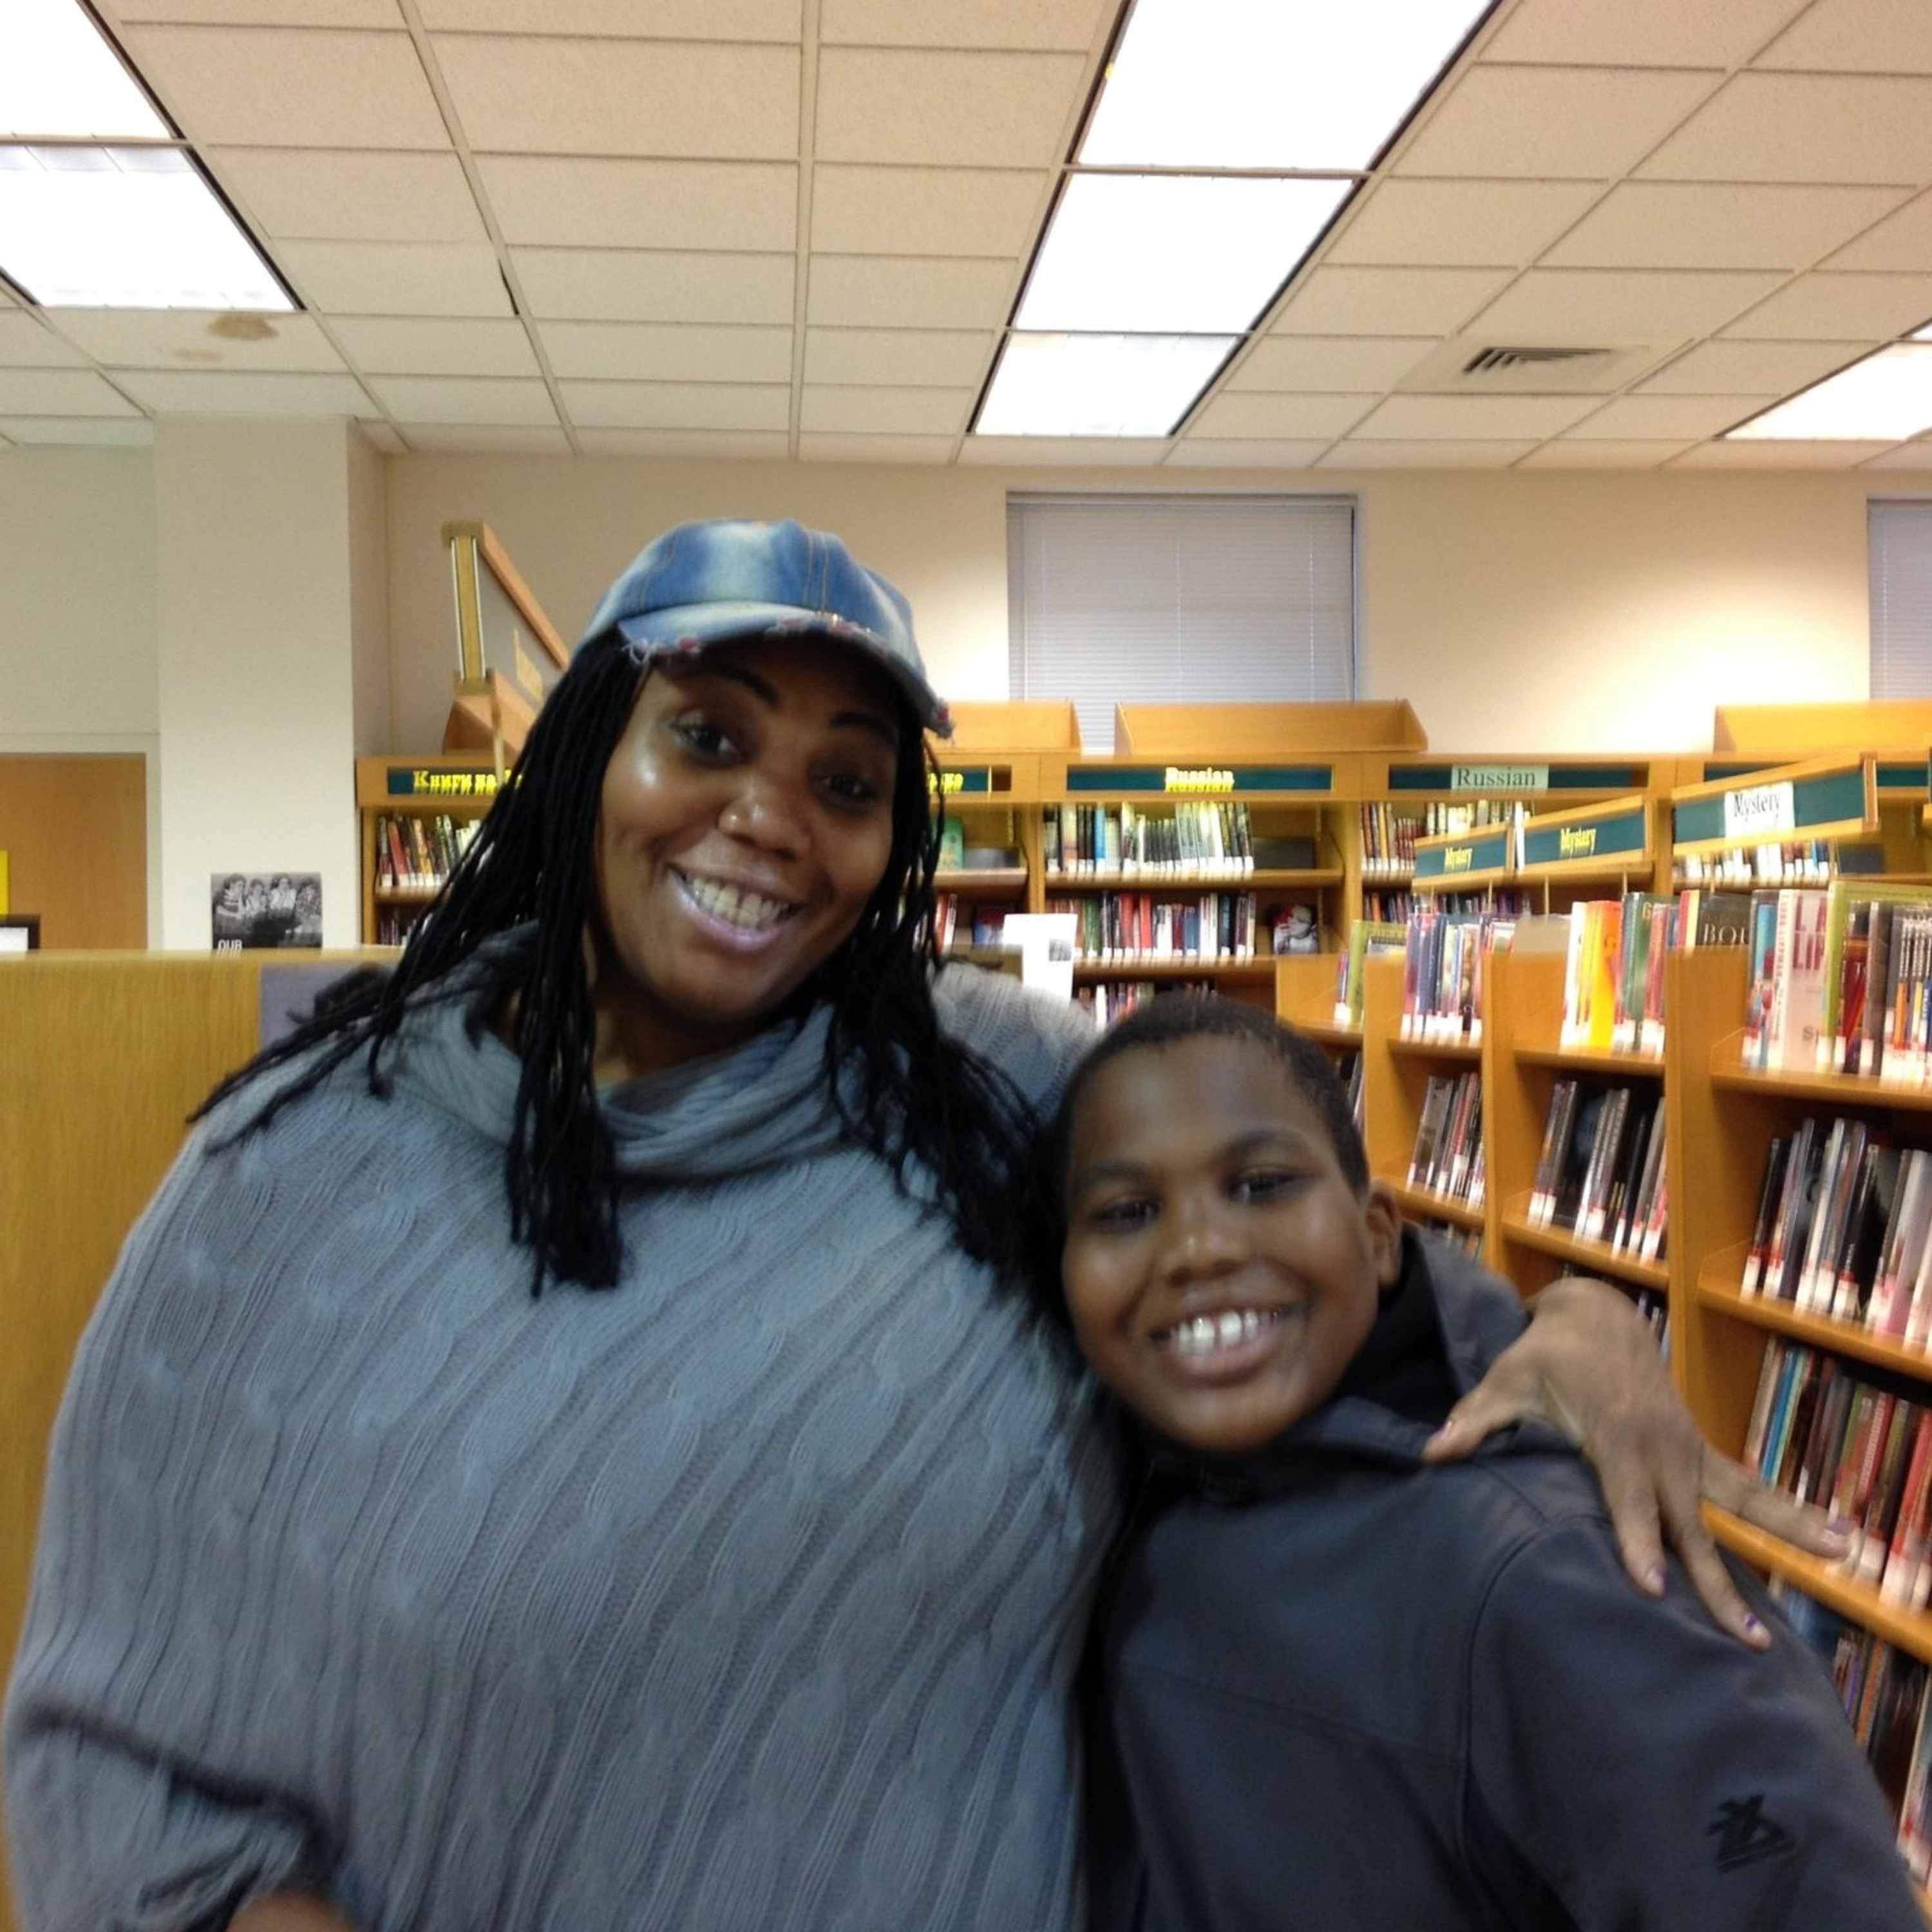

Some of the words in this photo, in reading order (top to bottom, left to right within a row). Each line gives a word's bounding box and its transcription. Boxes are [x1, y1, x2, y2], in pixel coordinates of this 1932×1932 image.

[1165, 766, 1235, 793] Russian
[1456, 765, 1536, 787] Russian
[1734, 791, 1780, 826] Mystery
[1559, 828, 1596, 861] Mystery
